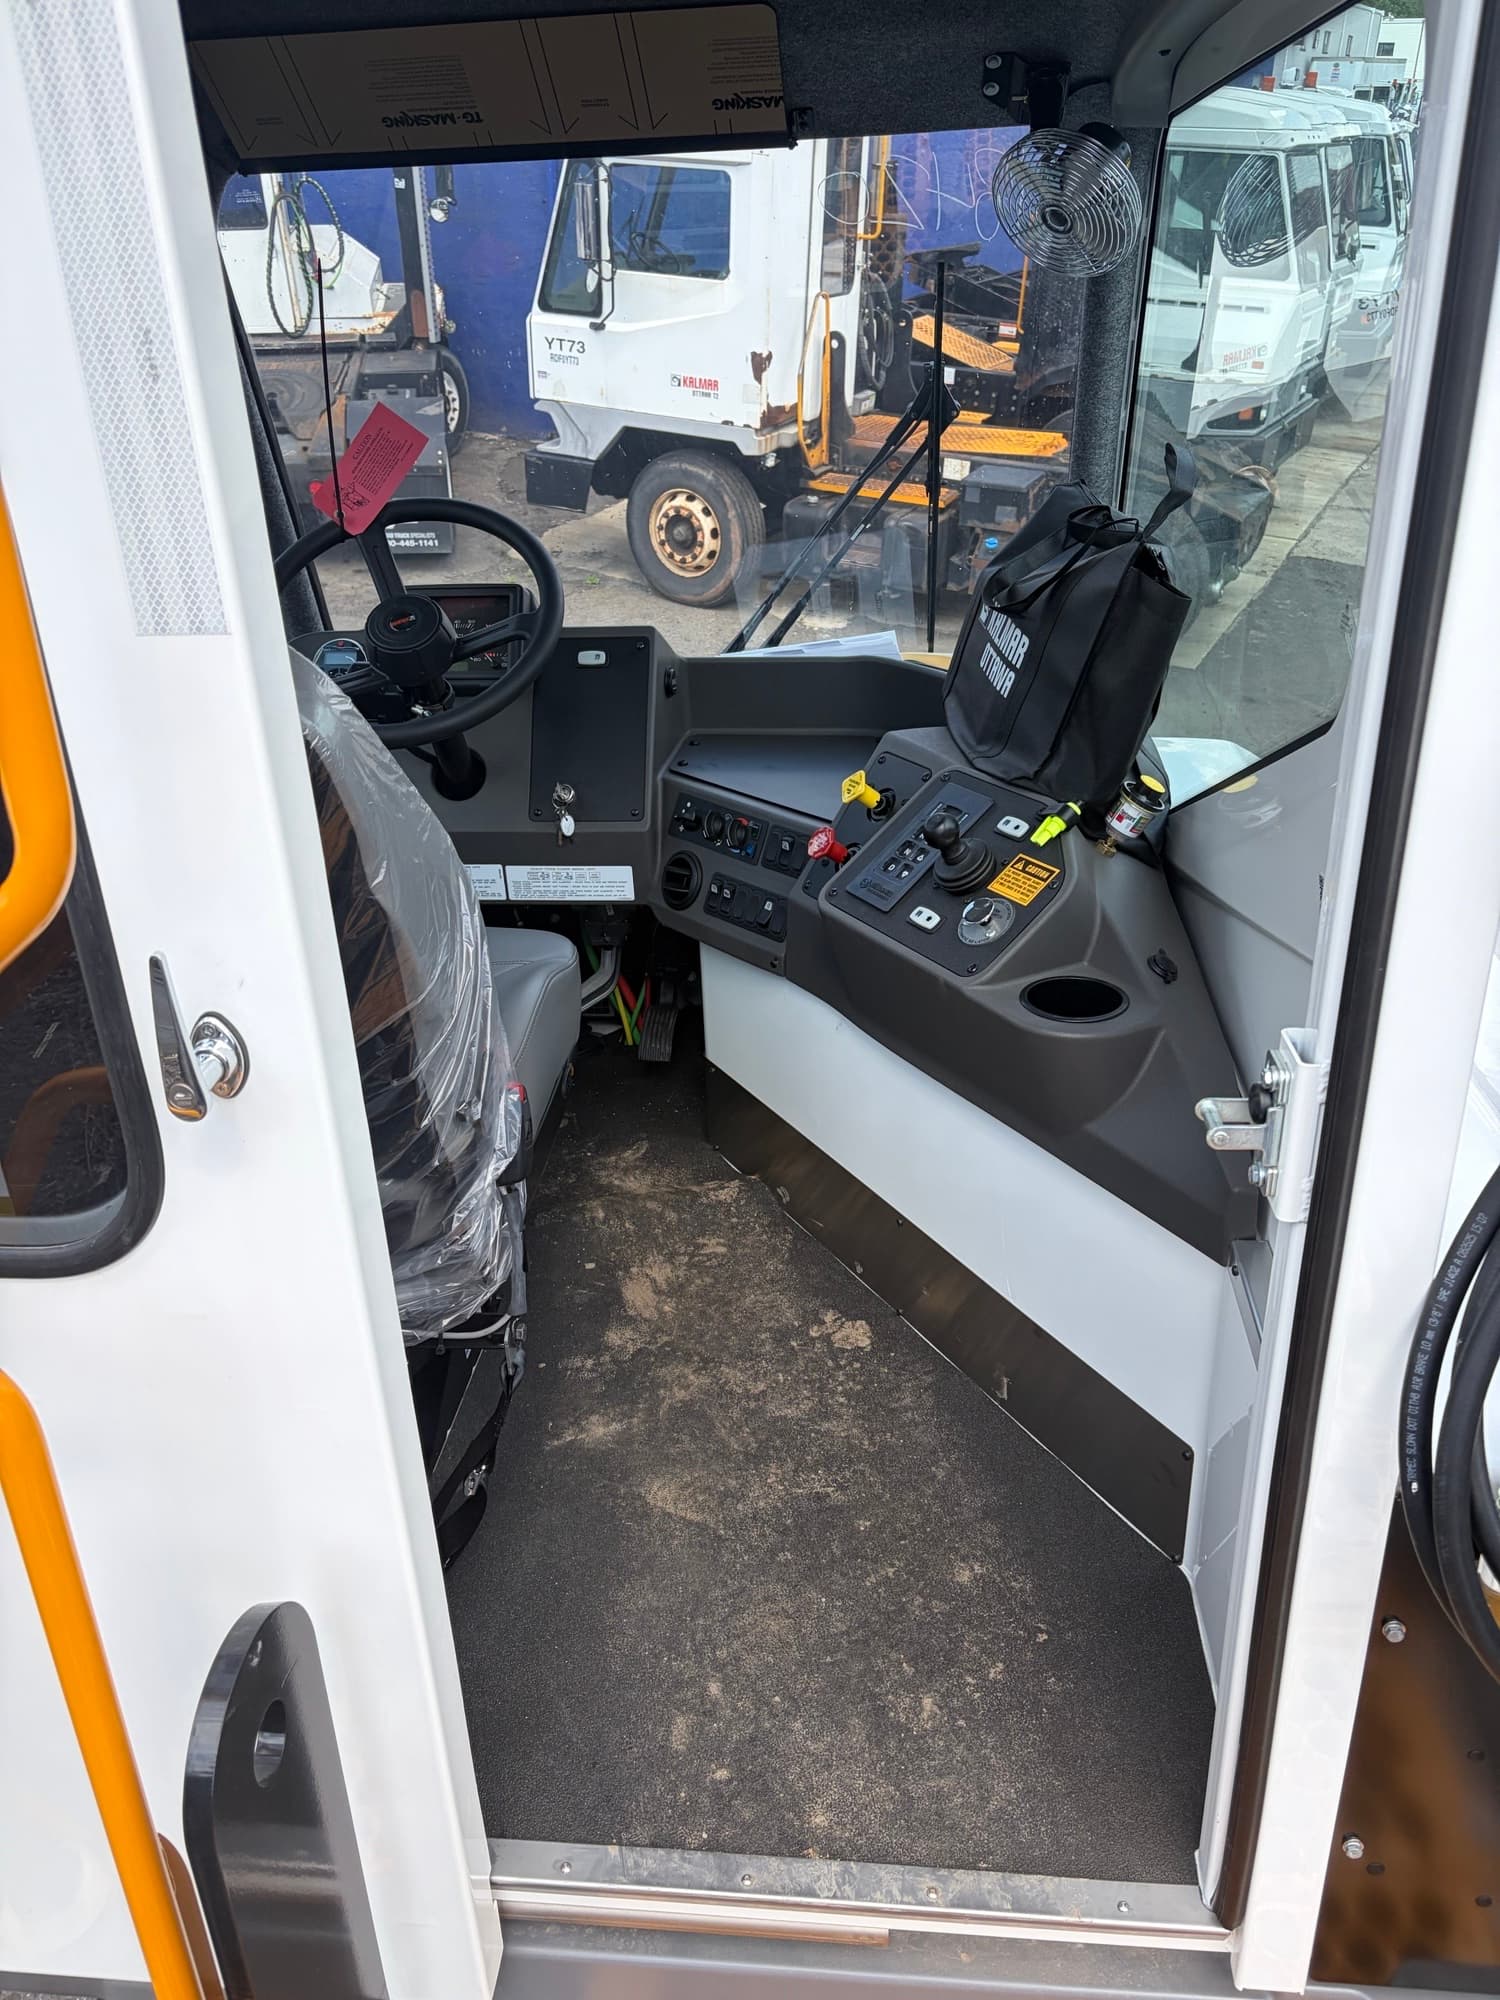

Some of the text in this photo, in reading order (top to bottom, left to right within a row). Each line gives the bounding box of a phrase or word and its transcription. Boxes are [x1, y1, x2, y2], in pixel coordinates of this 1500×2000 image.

[544, 336, 586, 354] YT73
[682, 375, 719, 392] KALMAR
[980, 641, 1016, 698] OTTAWA
[1025, 863, 1051, 879] CAUTION
